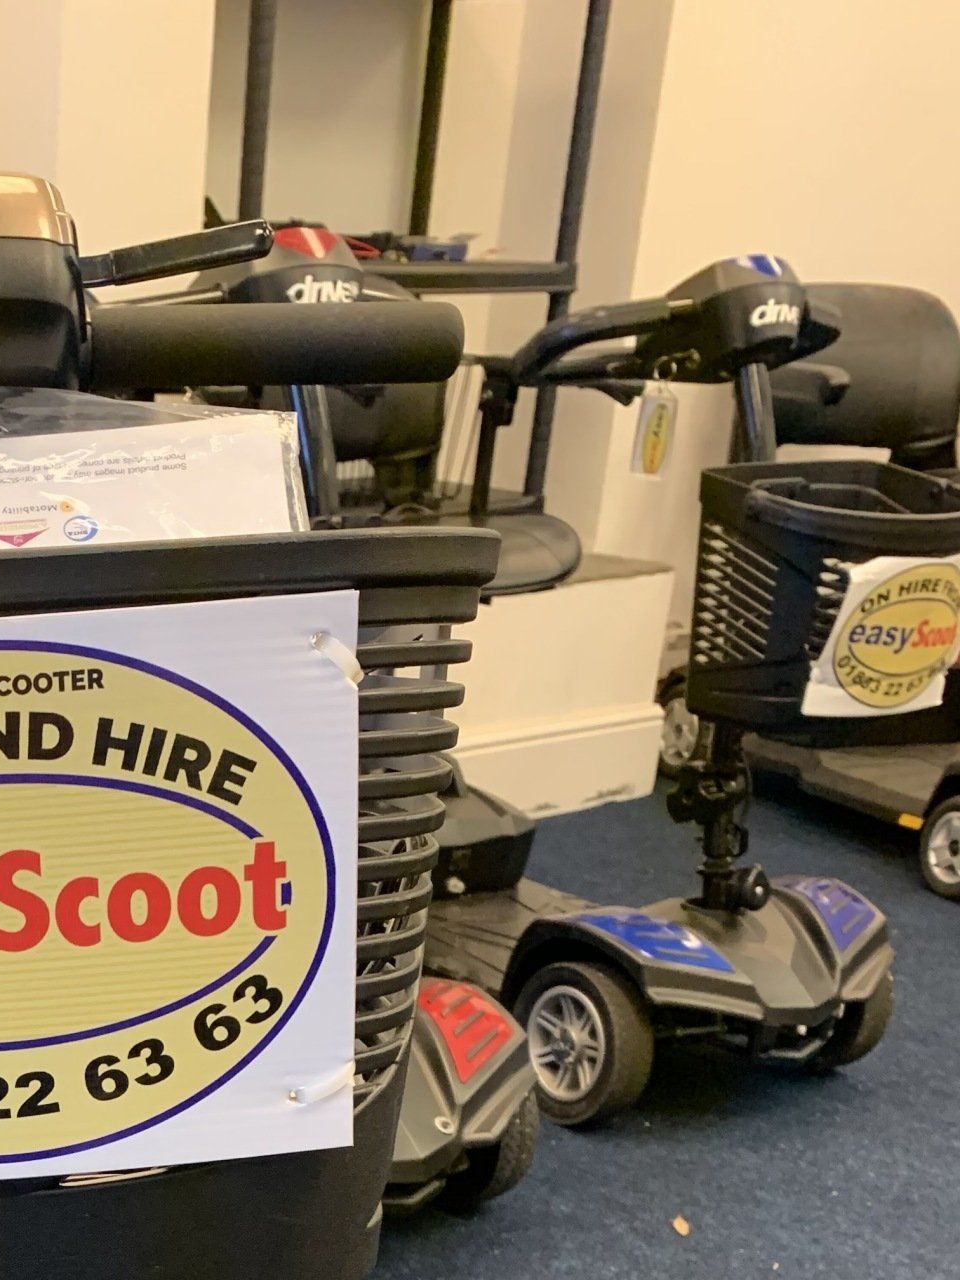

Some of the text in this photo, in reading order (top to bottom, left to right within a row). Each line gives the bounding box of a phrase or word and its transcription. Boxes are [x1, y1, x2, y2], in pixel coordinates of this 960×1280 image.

[94, 466, 124, 477] images
[127, 463, 159, 474] product
[162, 462, 186, 471] Some
[1, 503, 57, 514] Motability
[861, 590, 891, 613] ON
[898, 578, 943, 597] HIRE
[92, 717, 257, 806] HIRE
[84, 1036, 176, 1102] 63
[193, 972, 284, 1052] 63
